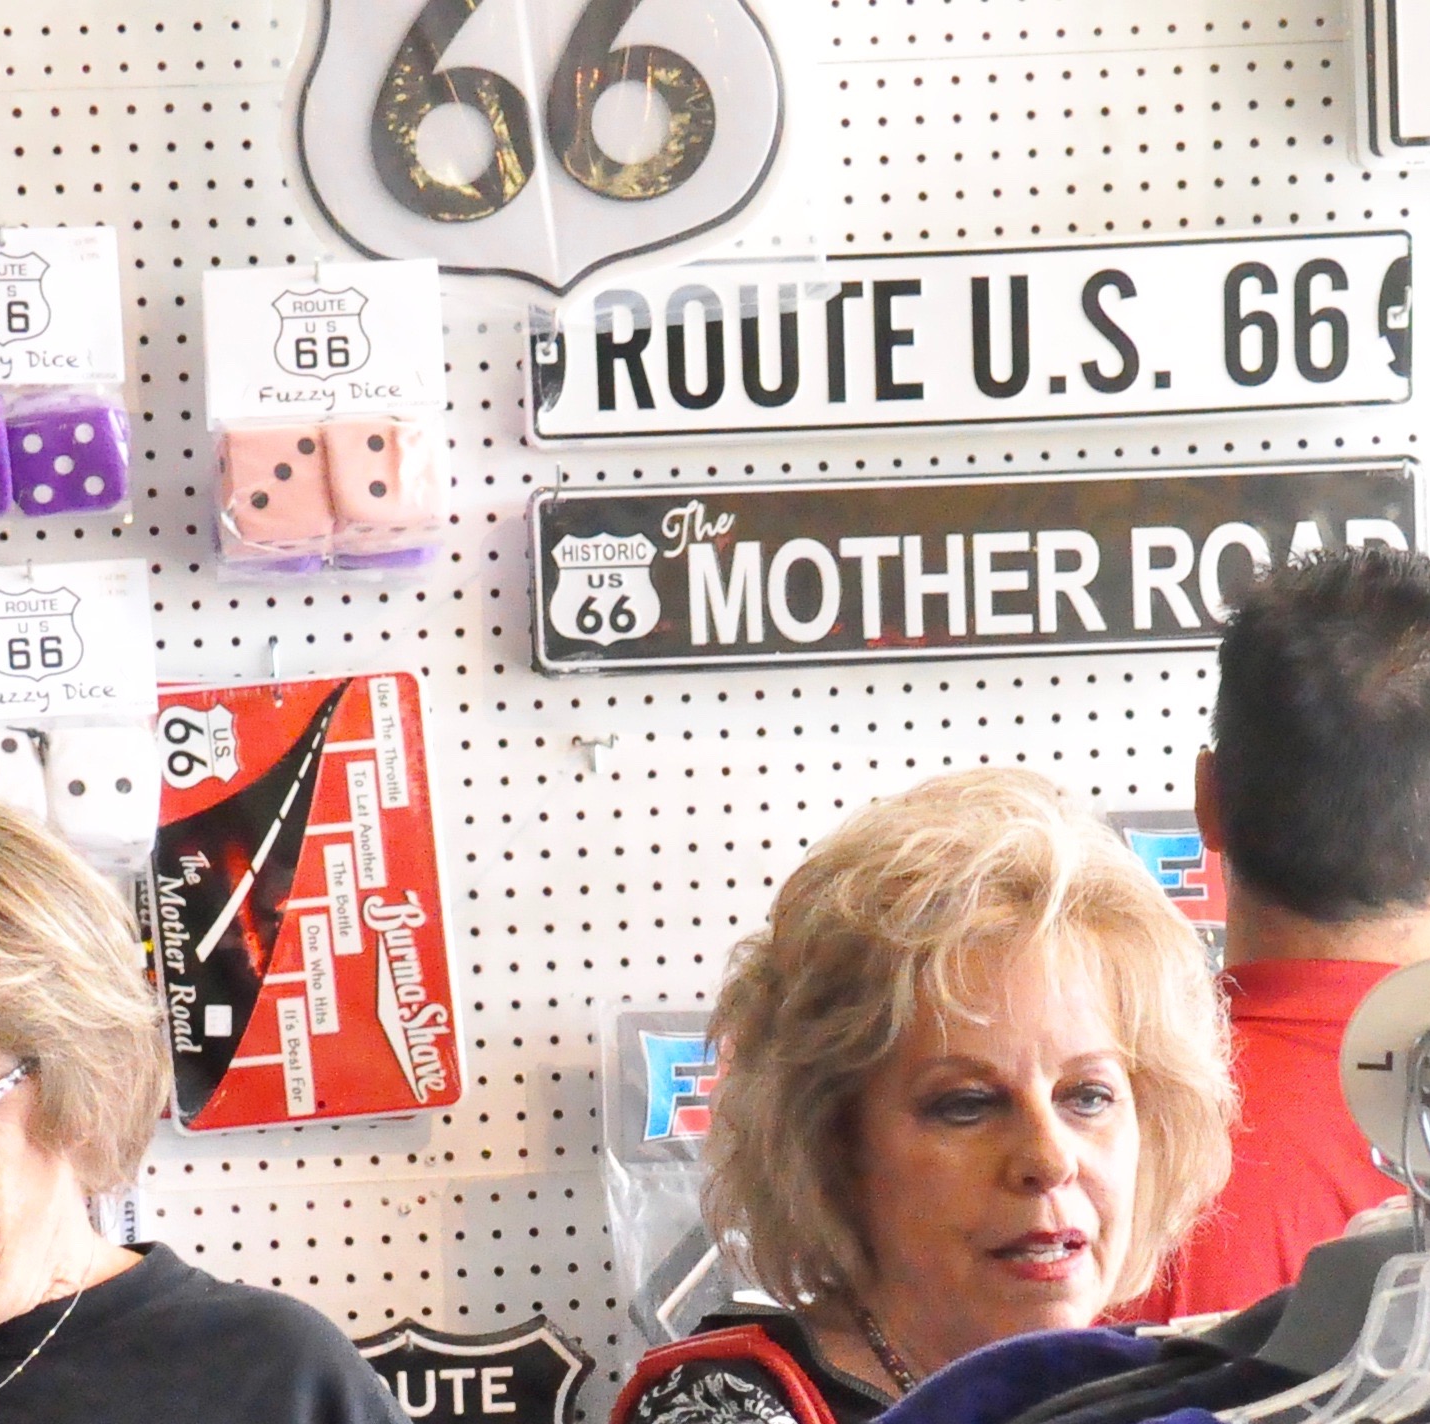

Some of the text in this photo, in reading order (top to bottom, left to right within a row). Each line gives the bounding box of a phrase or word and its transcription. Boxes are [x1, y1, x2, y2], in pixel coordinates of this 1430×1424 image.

[371, 0, 717, 222] 66
[292, 299, 347, 313] ROUTE
[295, 336, 350, 369] 66
[593, 258, 1349, 412] ROUTE U.S. 66
[26, 350, 80, 369] Dice
[259, 382, 402, 411] Fuzzy Dice
[662, 500, 736, 558] The
[562, 540, 647, 563] HISTORIC
[587, 573, 623, 589] US
[688, 529, 1107, 646] MOTHER
[5, 599, 59, 613] ROUTE
[576, 595, 637, 635] 66
[8, 636, 63, 670] 66
[62, 682, 117, 700] Dice
[163, 717, 208, 777] 66
[212, 727, 232, 761] U.S.
[376, 682, 399, 804] Use The Throttle
[354, 770, 376, 882] To Let Another
[178, 849, 211, 886] The
[332, 861, 350, 938] The Bottle
[157, 872, 203, 1054] Mother Road
[306, 924, 328, 1026] One Who Hits
[283, 1008, 306, 1104] It's Best For
[1357, 1051, 1393, 1071] L
[377, 1366, 517, 1418] UTE
